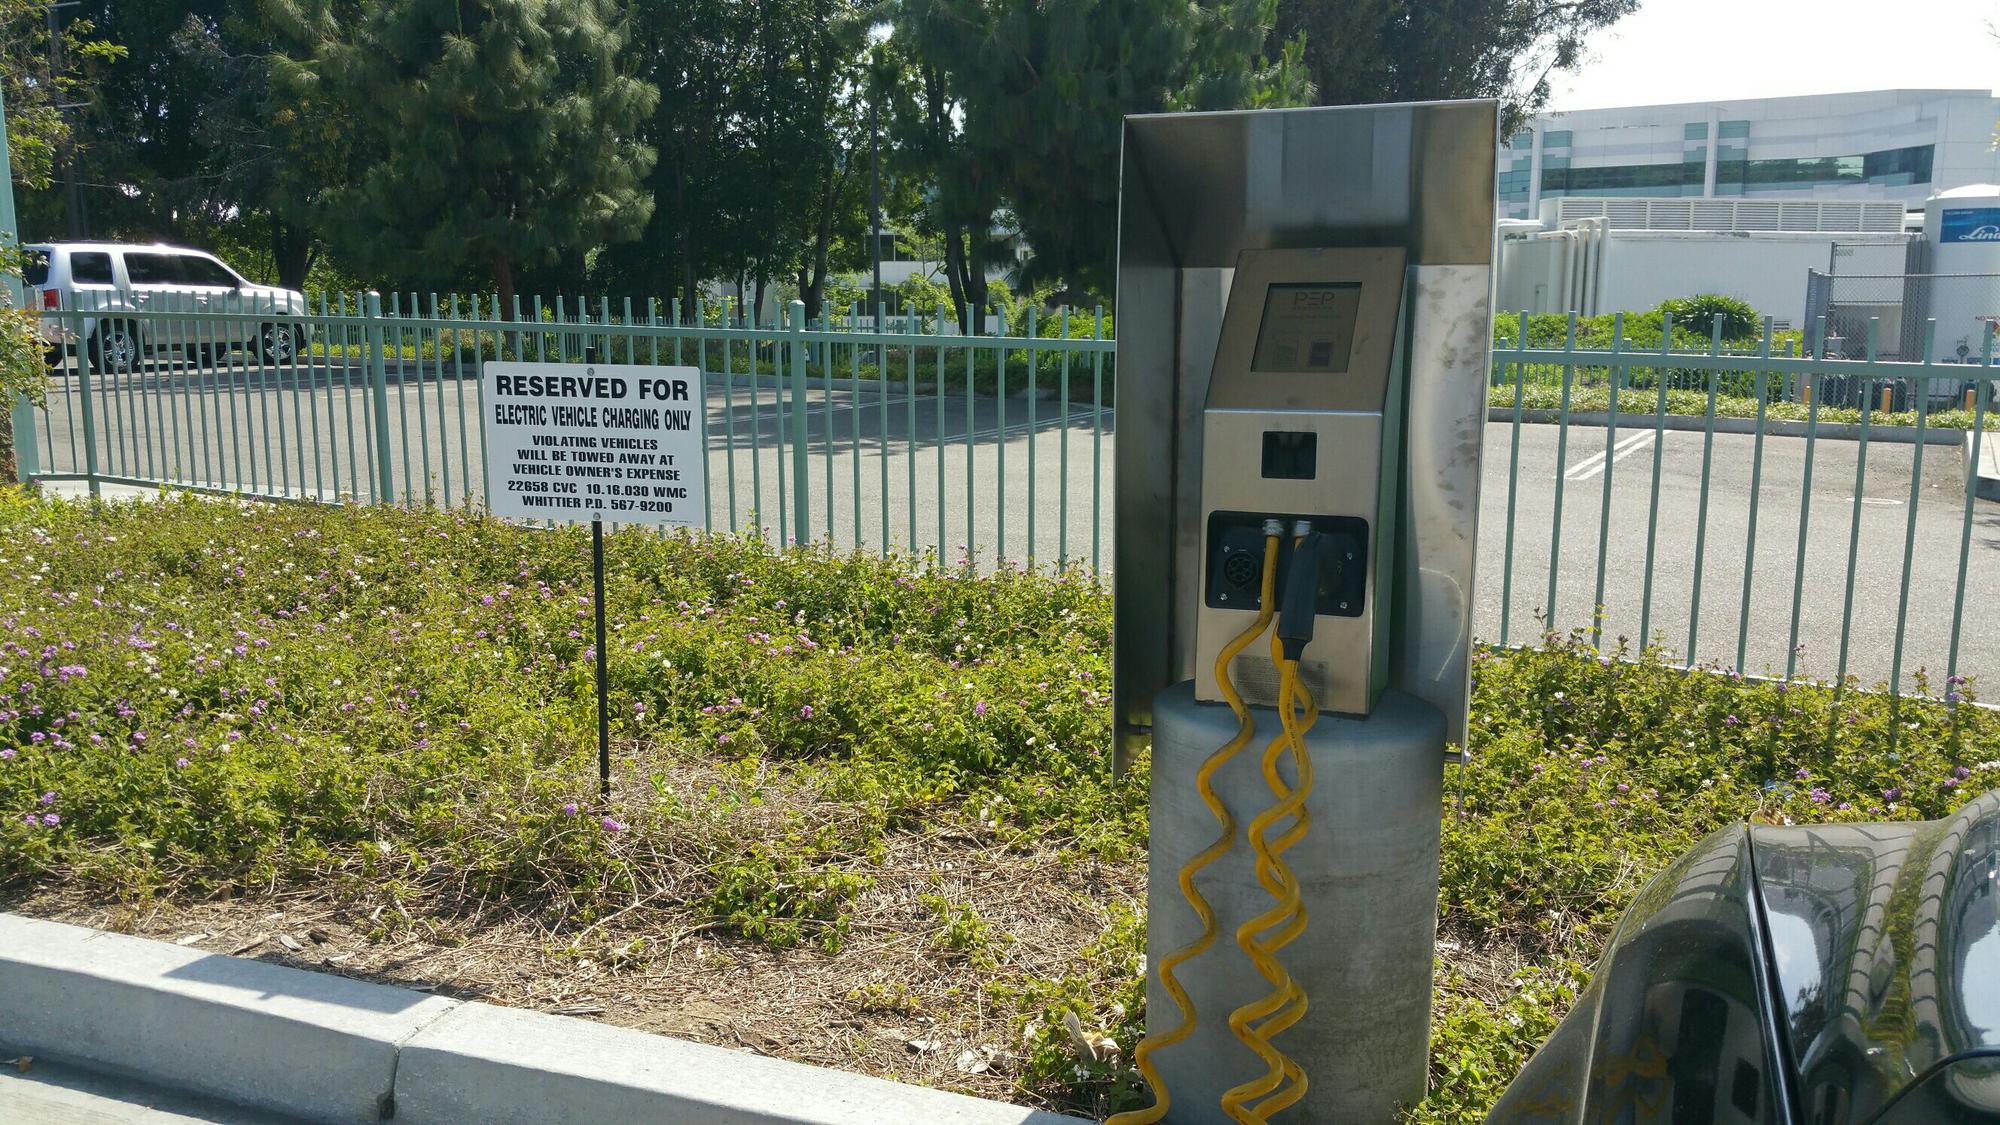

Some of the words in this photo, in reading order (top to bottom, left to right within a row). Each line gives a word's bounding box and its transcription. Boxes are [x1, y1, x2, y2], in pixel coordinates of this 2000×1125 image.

[496, 375, 627, 399] RESERVED
[639, 379, 688, 401] FOR
[495, 404, 546, 426] ELECTRIC
[552, 406, 597, 427] VEHICLE
[603, 408, 659, 429] CHARGING
[665, 410, 691, 430] ONLY
[532, 435, 597, 448] VIOLATING
[601, 437, 658, 450] VEHICLES
[517, 449, 548, 461] WILL
[552, 450, 566, 461] BE
[571, 451, 614, 463] TOWED
[619, 453, 655, 464] AWAY
[659, 455, 674, 465] AT
[513, 464, 561, 476] VEHICLE
[566, 466, 622, 478] OWNER'S
[627, 469, 680, 481] EXPENSE
[508, 481, 548, 492] 22658
[553, 483, 577, 493] CVC
[586, 484, 649, 497] 10.16.030
[654, 487, 687, 498] WMC
[522, 496, 581, 508] WHITTIER
[586, 499, 606, 509] P.D.
[611, 500, 672, 512] 567-9200
